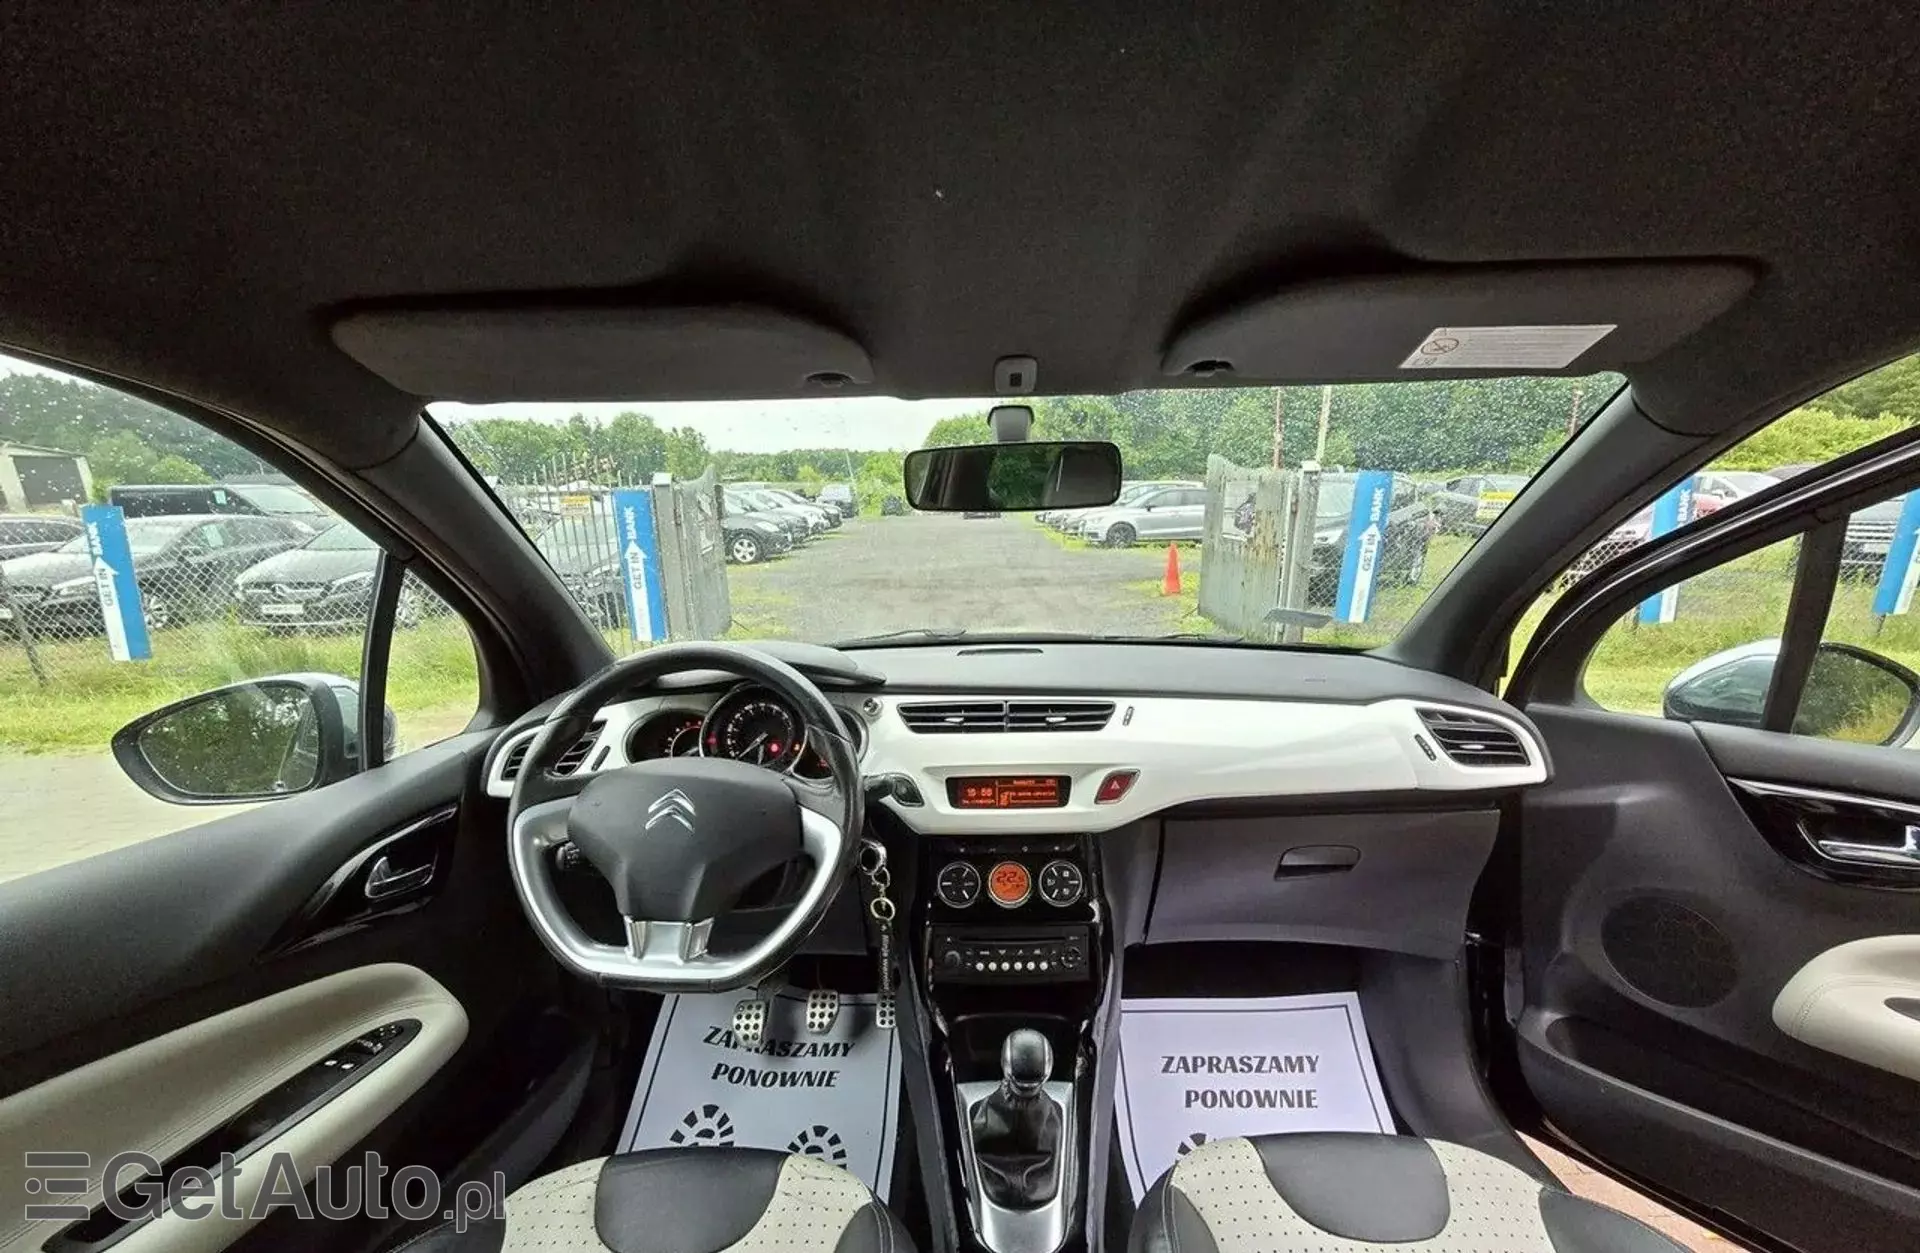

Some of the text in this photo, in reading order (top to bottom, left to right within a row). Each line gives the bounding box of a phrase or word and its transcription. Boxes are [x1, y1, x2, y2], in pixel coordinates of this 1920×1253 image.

[1370, 487, 1385, 521] BANK
[623, 506, 637, 540] BANK
[703, 1026, 856, 1058] ZAASZAMY
[711, 1062, 842, 1088] PONOWNIE
[1161, 1055, 1319, 1074] ZAPRASZAMY
[1185, 1089, 1318, 1109] PONOWNIE
